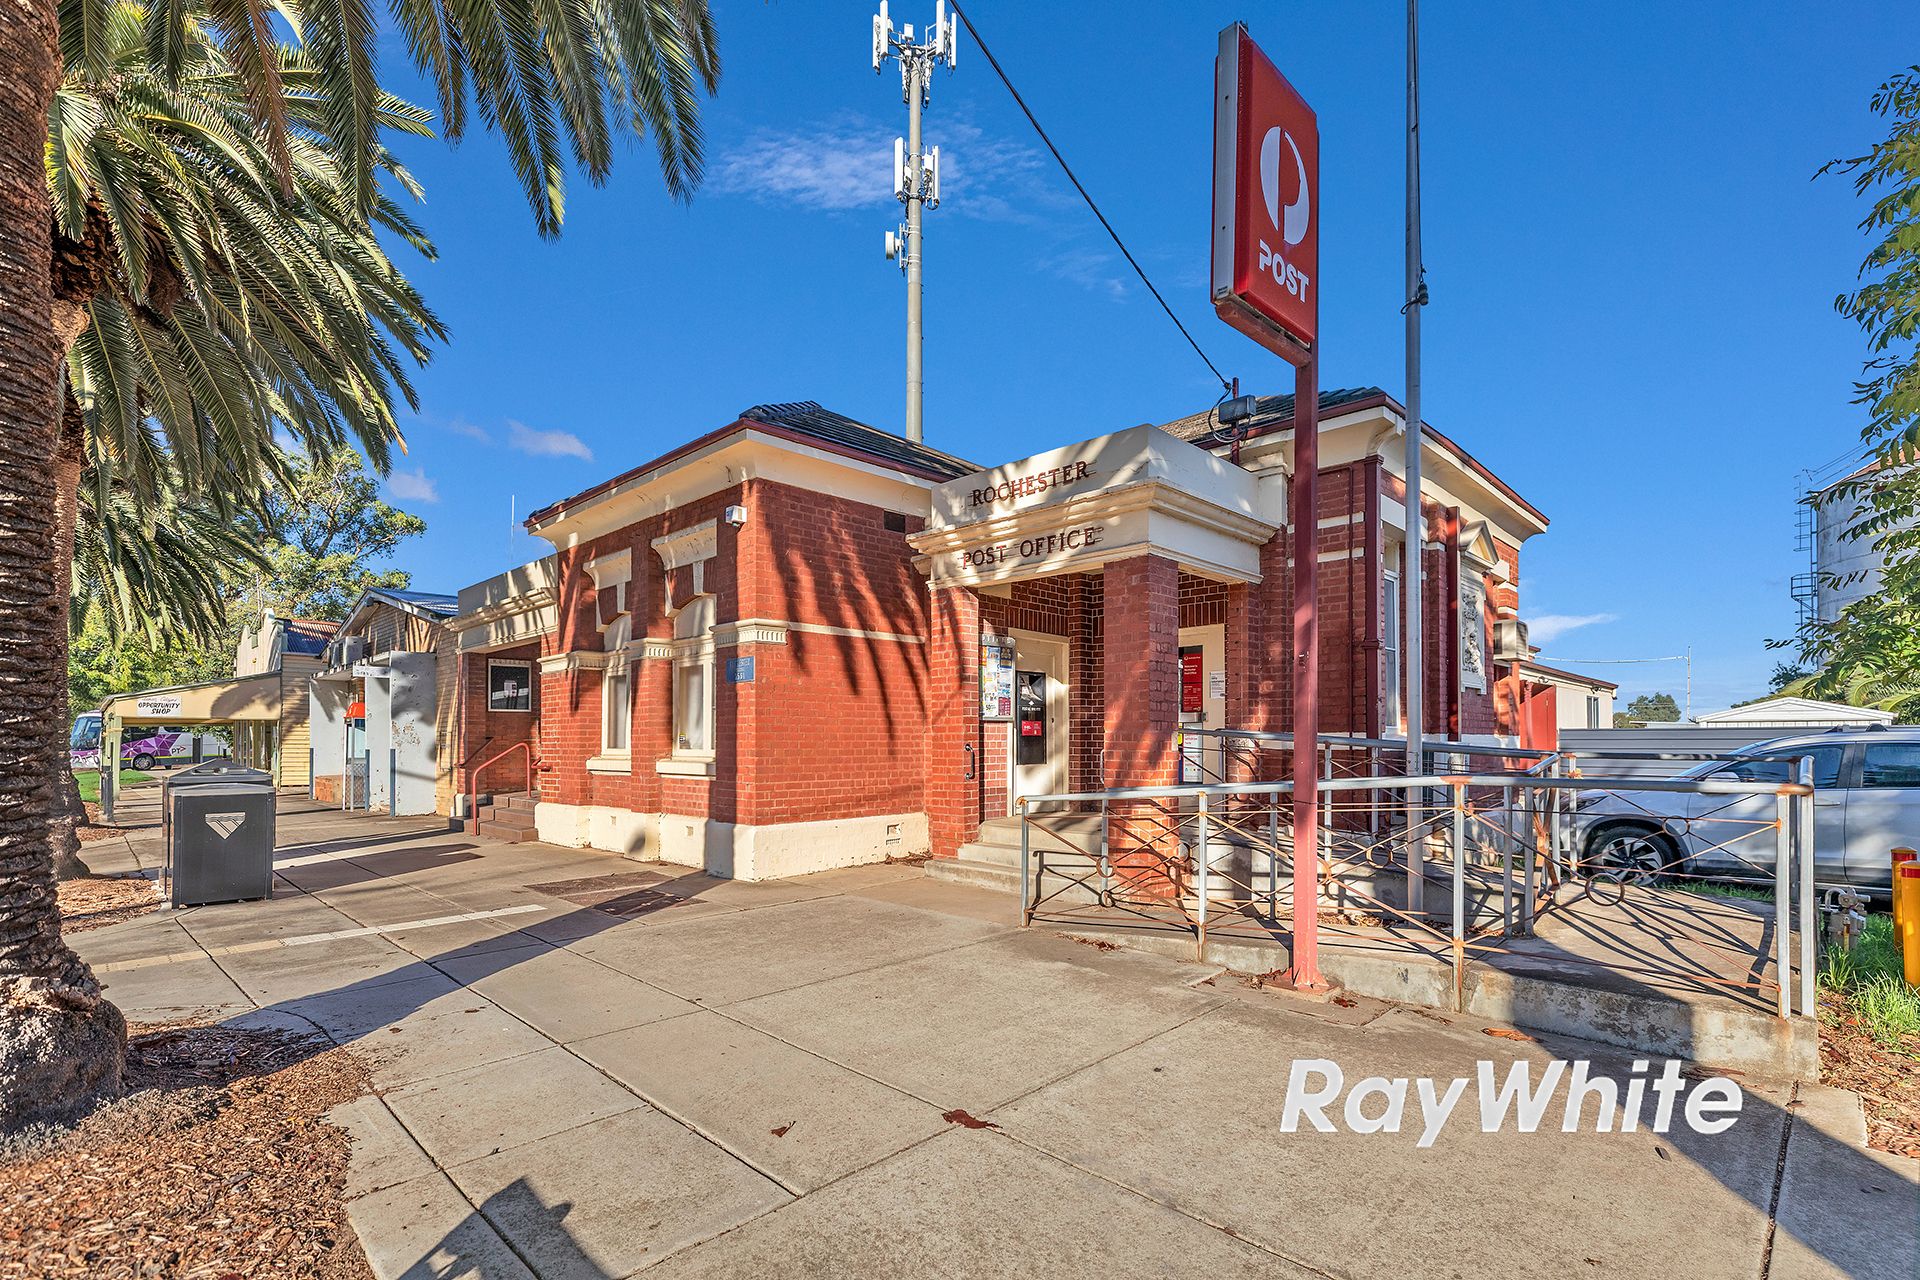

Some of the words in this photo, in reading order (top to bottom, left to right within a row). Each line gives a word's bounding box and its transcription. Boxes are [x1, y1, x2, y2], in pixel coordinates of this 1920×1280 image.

[1259, 239, 1309, 302] POST
[971, 460, 1089, 507] ROCHESTER
[962, 545, 1007, 570] POST
[1019, 527, 1096, 558] OFFICE
